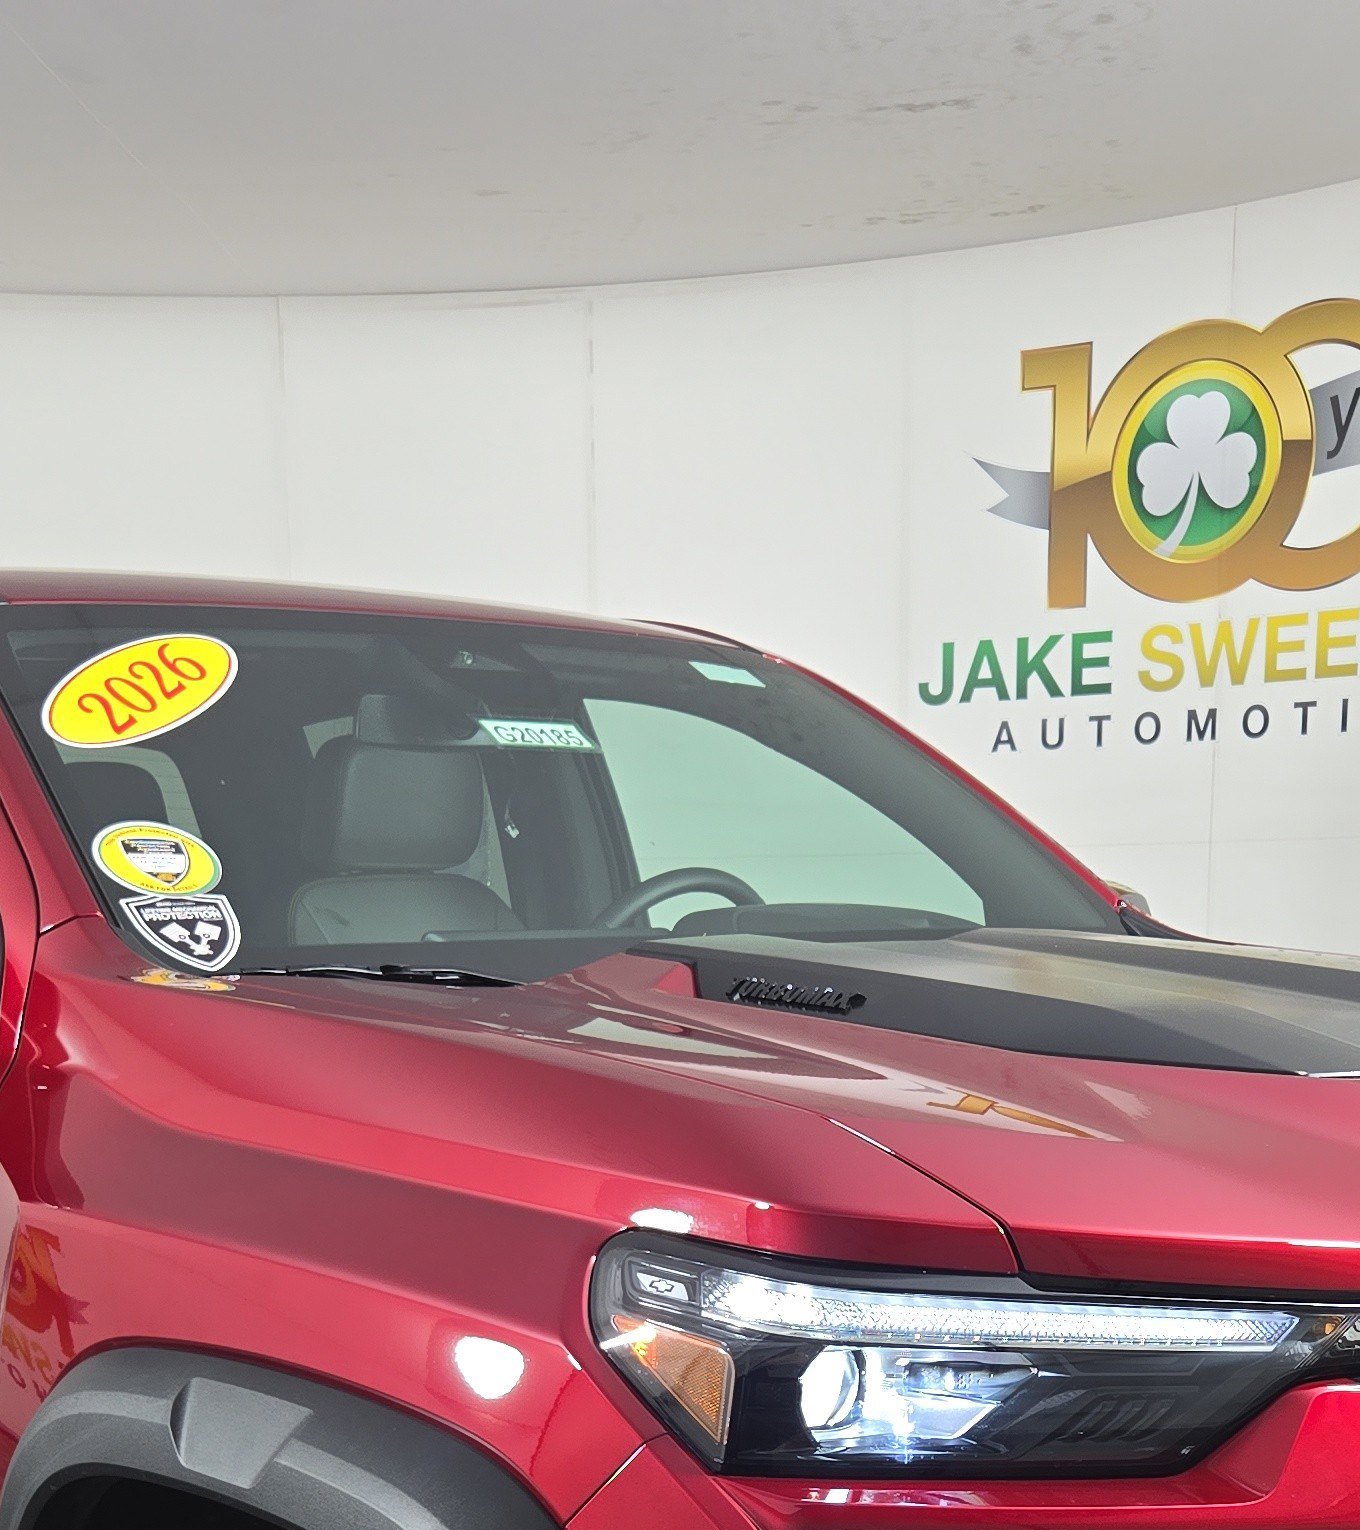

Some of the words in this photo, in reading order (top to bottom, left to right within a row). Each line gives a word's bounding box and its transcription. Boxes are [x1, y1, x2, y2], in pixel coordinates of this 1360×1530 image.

[77, 642, 207, 735] 2026
[918, 630, 1113, 706] JAKE
[494, 726, 583, 747] G20185
[144, 911, 223, 921] PROTECTION
